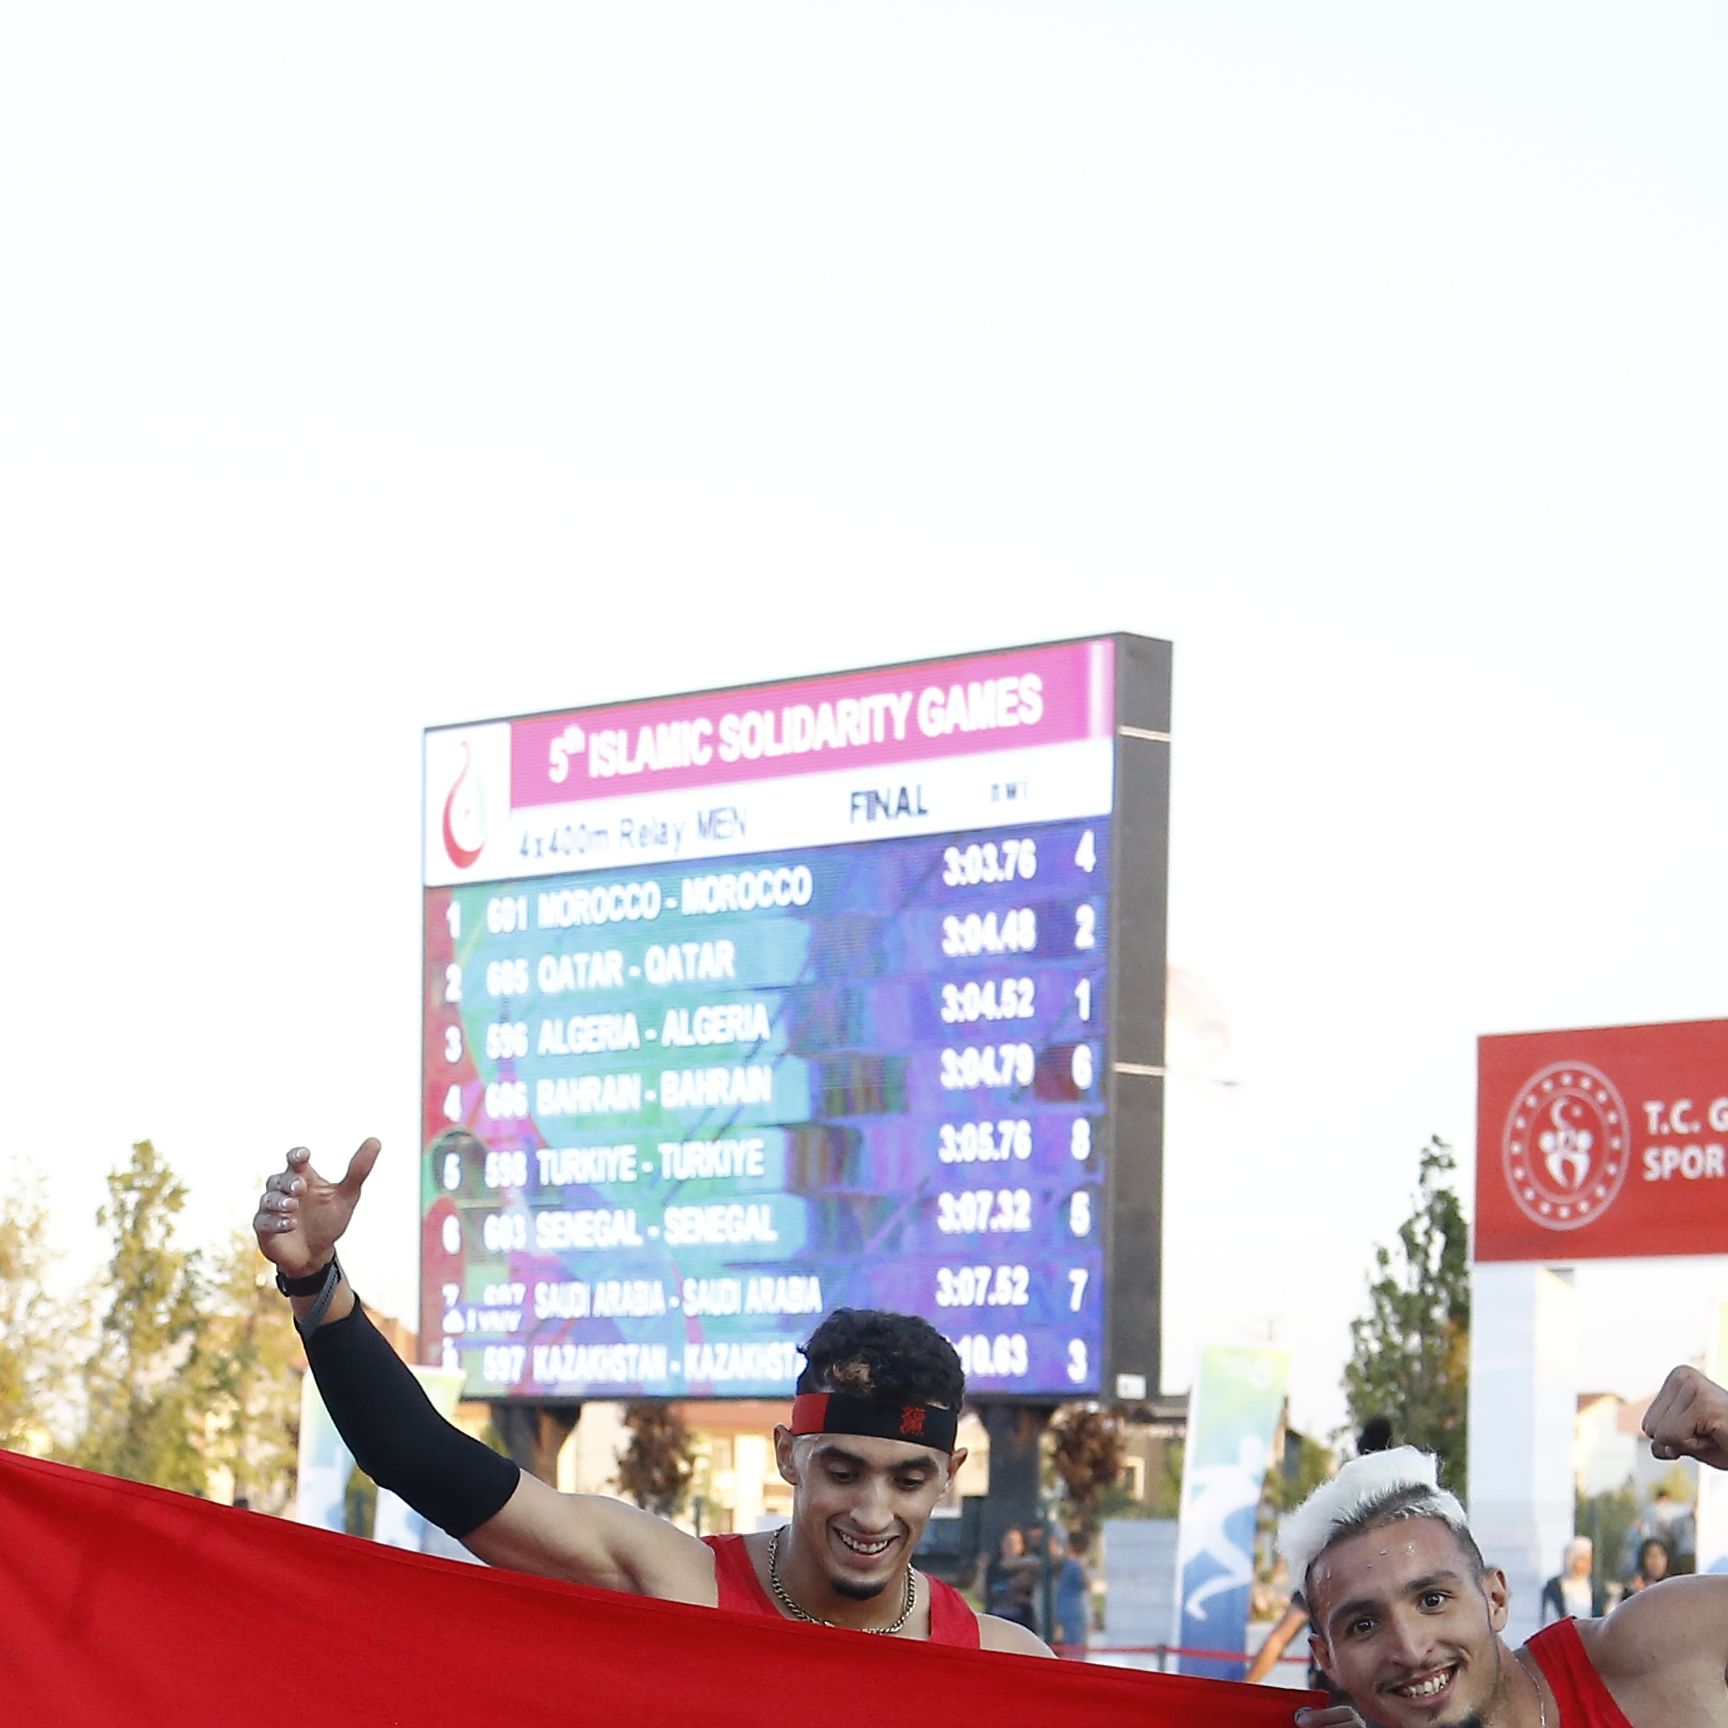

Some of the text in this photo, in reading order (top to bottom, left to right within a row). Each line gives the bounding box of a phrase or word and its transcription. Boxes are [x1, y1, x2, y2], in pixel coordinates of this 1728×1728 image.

[588, 717, 714, 778] ISLAMIC
[718, 690, 914, 763] SOLIDARITY
[917, 673, 1043, 737] GAMES
[620, 816, 684, 853] Relay
[697, 806, 747, 841] MEN
[849, 784, 929, 824] FINAL
[446, 901, 461, 938] 1
[486, 895, 528, 933] 601
[537, 881, 662, 929] MOROCCO
[681, 865, 813, 916] MOROCCO
[943, 838, 1037, 887] 3:03.76
[1075, 829, 1096, 873] 4
[446, 963, 463, 1001] 2
[537, 949, 623, 995] QATAR
[644, 939, 735, 985] QATAR
[941, 908, 1037, 958] 3:04.48
[1075, 903, 1096, 950] 2
[444, 1025, 462, 1063] 3
[537, 1012, 640, 1056] ALGERIA
[661, 1003, 771, 1048] ALGERIA
[941, 977, 1035, 1024] 3:04.52
[1075, 978, 1091, 1022] 1
[443, 1083, 462, 1123] 4
[536, 1072, 642, 1116] BAHRAIN
[660, 1065, 772, 1109] BAHRAIN
[940, 1042, 1035, 1090] 3:04.79
[1072, 1044, 1093, 1090] 6
[1643, 1099, 1701, 1135] T.C.
[444, 1152, 461, 1191] 5
[938, 1119, 1032, 1164] 3:05.76
[1071, 1118, 1091, 1160] 8
[1642, 1143, 1726, 1182] SPOR
[442, 1214, 461, 1254] 6
[536, 1209, 643, 1249] SENEGAL
[664, 1204, 779, 1245] SENEGAL
[937, 1188, 1032, 1234] 3:07.32
[1069, 1190, 1091, 1237] 5
[534, 1282, 591, 1320] SAUDI
[593, 1279, 666, 1318] ARABIA
[682, 1278, 741, 1317] SAUDI
[745, 1275, 823, 1315] ARABIA
[935, 1264, 1029, 1308] 3:07.52
[1068, 1267, 1088, 1312] 7
[532, 1343, 668, 1382] KAZAKHSTAN
[954, 1333, 1028, 1377] 10.63
[1067, 1338, 1088, 1384] 3
